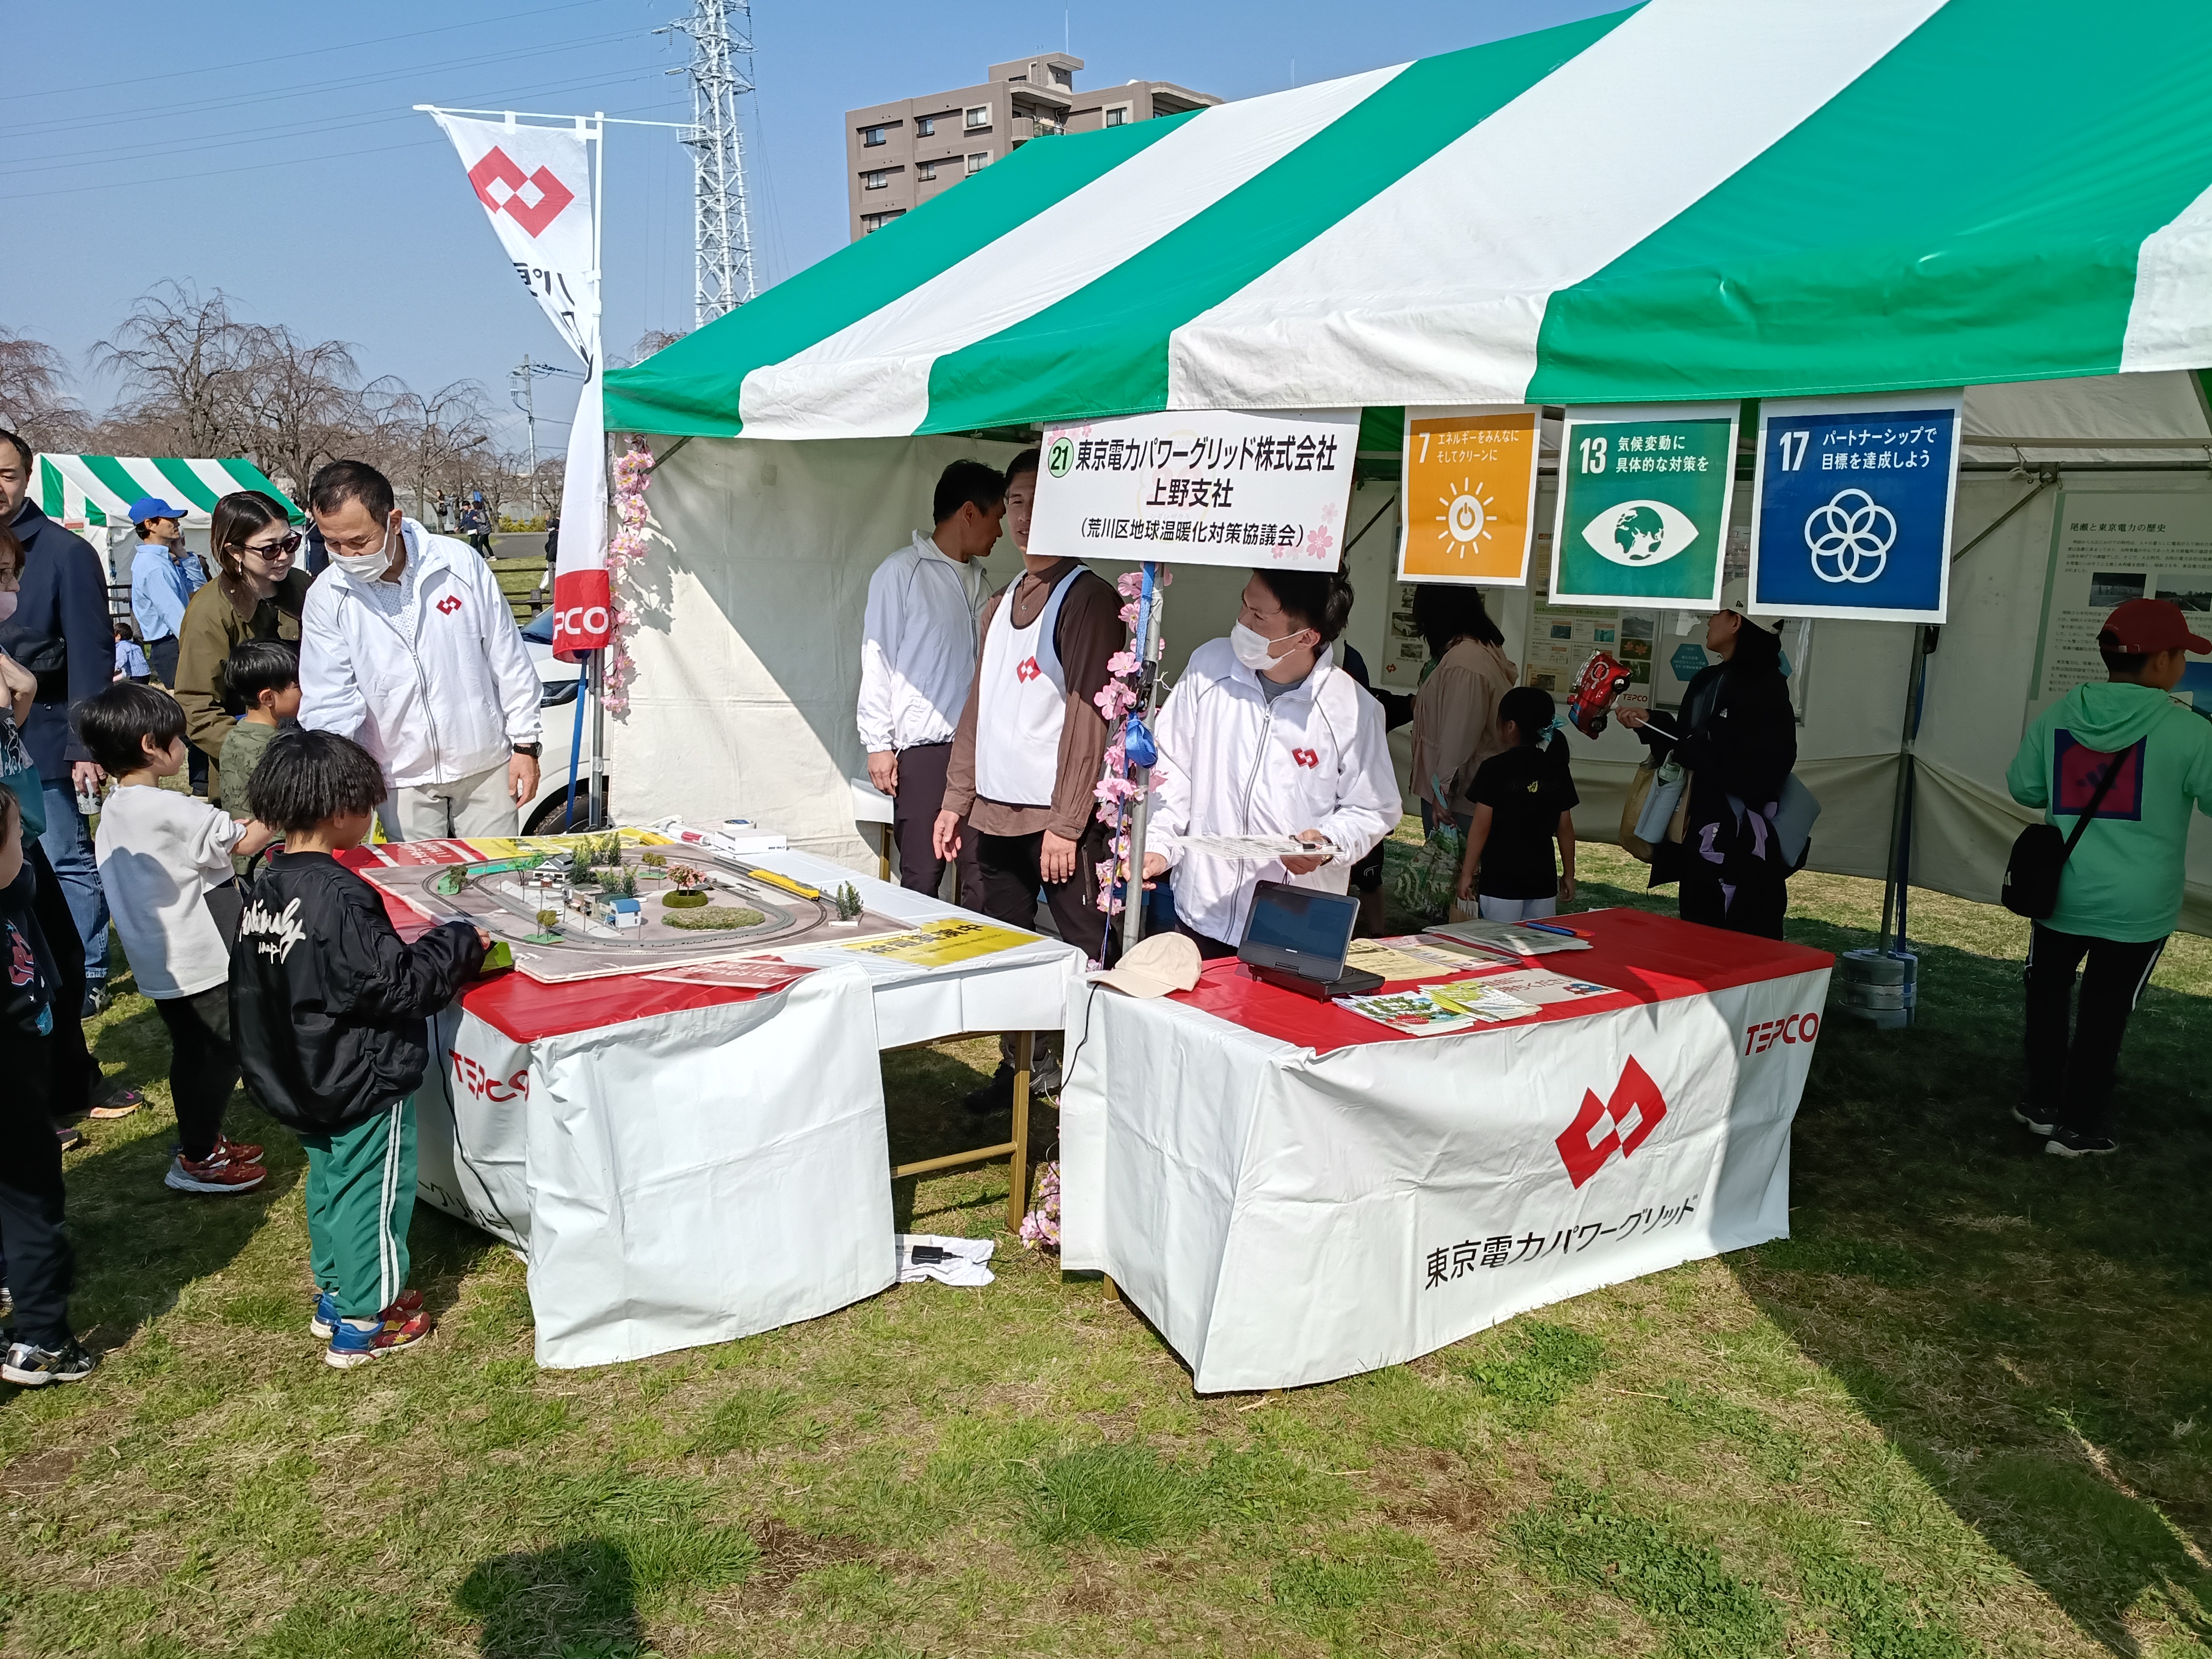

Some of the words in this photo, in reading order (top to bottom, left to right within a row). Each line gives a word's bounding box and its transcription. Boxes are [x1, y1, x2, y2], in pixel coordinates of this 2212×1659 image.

[1050, 447, 1068, 470] 21
[1076, 434, 1338, 473] 東京電力パワーグリッド株式会社
[1419, 433, 1431, 463] 7
[1437, 429, 1519, 446] エネルギーをみんなに
[1437, 449, 1498, 463] そしてクリーンに
[1580, 437, 1607, 474] 13
[1617, 435, 1685, 452] 気候変動に
[1779, 431, 1810, 471] 17
[1823, 426, 1938, 447] パートナーシップで
[1822, 449, 1931, 470] 目標を達成しよう
[1615, 455, 1709, 473] 具体的な対策を
[1146, 478, 1235, 509] 上野支社
[1081, 518, 1304, 548] （荒川区地球温暖化対策協議会）
[2069, 522, 2167, 532] 尾瀬と東京電力の歴史
[554, 606, 609, 640] PCO
[1623, 694, 1648, 702] TEPCO
[1745, 1012, 1819, 1056] TEPCO
[1425, 1193, 1698, 1291] 東京電力パワーグリッド
